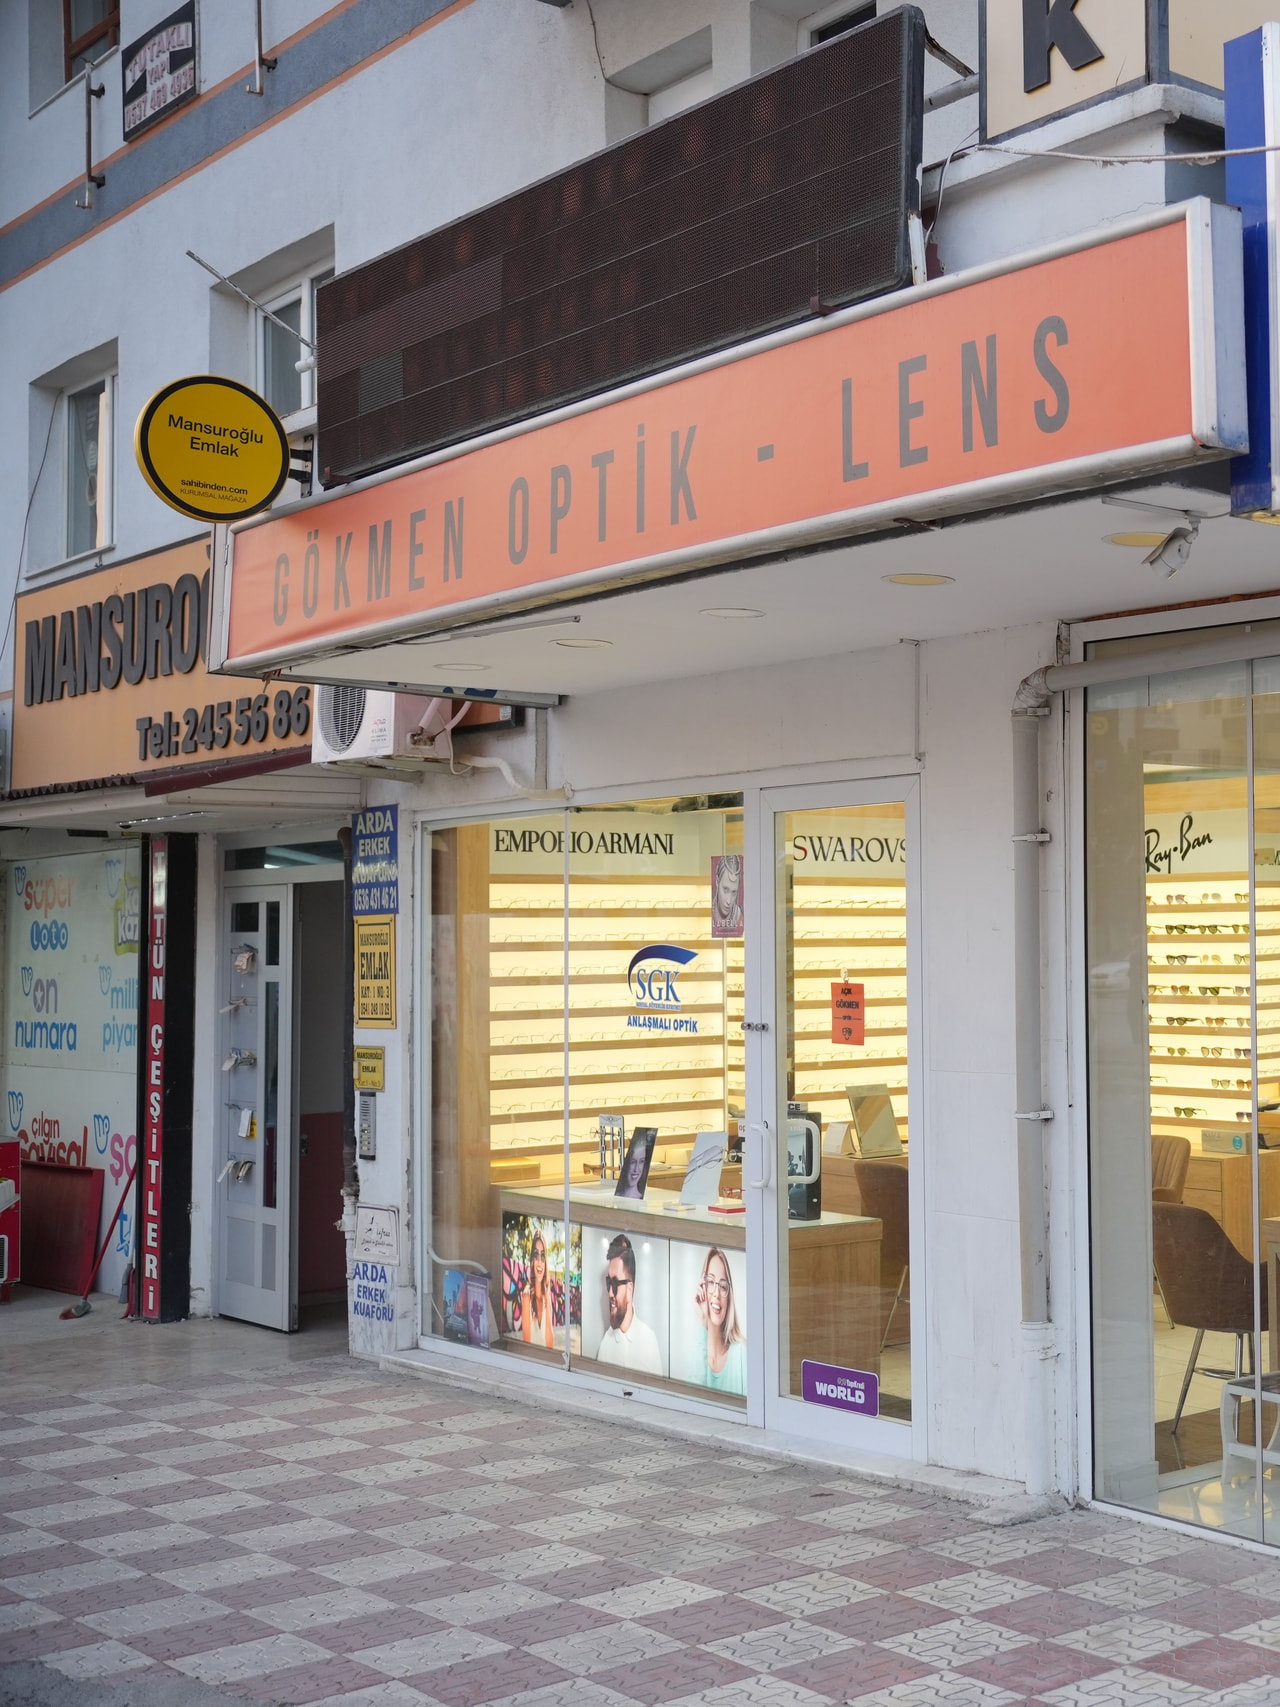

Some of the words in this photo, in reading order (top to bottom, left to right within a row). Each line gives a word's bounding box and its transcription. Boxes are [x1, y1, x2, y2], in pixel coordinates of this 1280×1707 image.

[128, 23, 191, 83] TUTAKLI
[168, 413, 264, 445] Mansuroğlu
[190, 436, 240, 458] Emlak
[272, 496, 465, 626] GÖKMEN
[508, 423, 698, 565] OPTİK
[757, 443, 775, 463] -
[841, 314, 1070, 483] LENS
[180, 478, 248, 496] sahibinden.com
[180, 487, 217, 500] KURUMSAL
[218, 492, 248, 504] MAĞAZA
[136, 711, 180, 761] Tel:
[181, 701, 232, 754] 245
[233, 692, 270, 745] 56
[272, 685, 311, 739] 86
[355, 809, 394, 836] ARDA
[358, 836, 391, 857] ERKEK
[594, 831, 675, 856] ARMANI
[24, 877, 75, 918] süper
[31, 920, 68, 949] loto
[360, 951, 389, 980] EMLAK
[635, 968, 681, 1003] SGK
[15, 1020, 77, 1051] numara
[627, 1015, 672, 1032] ANLAŞMALI
[673, 1016, 698, 1033] OPTİK
[361, 1065, 377, 1074] EMLAK
[31, 1111, 60, 1145] çılgın
[145, 1023, 163, 1311] ÇEŞİTLERİ
[353, 1262, 388, 1284] ARDA
[356, 1284, 386, 1304] ERKEK
[353, 1300, 394, 1322] KUAFÖRÜ
[815, 1381, 866, 1405] WORLD
